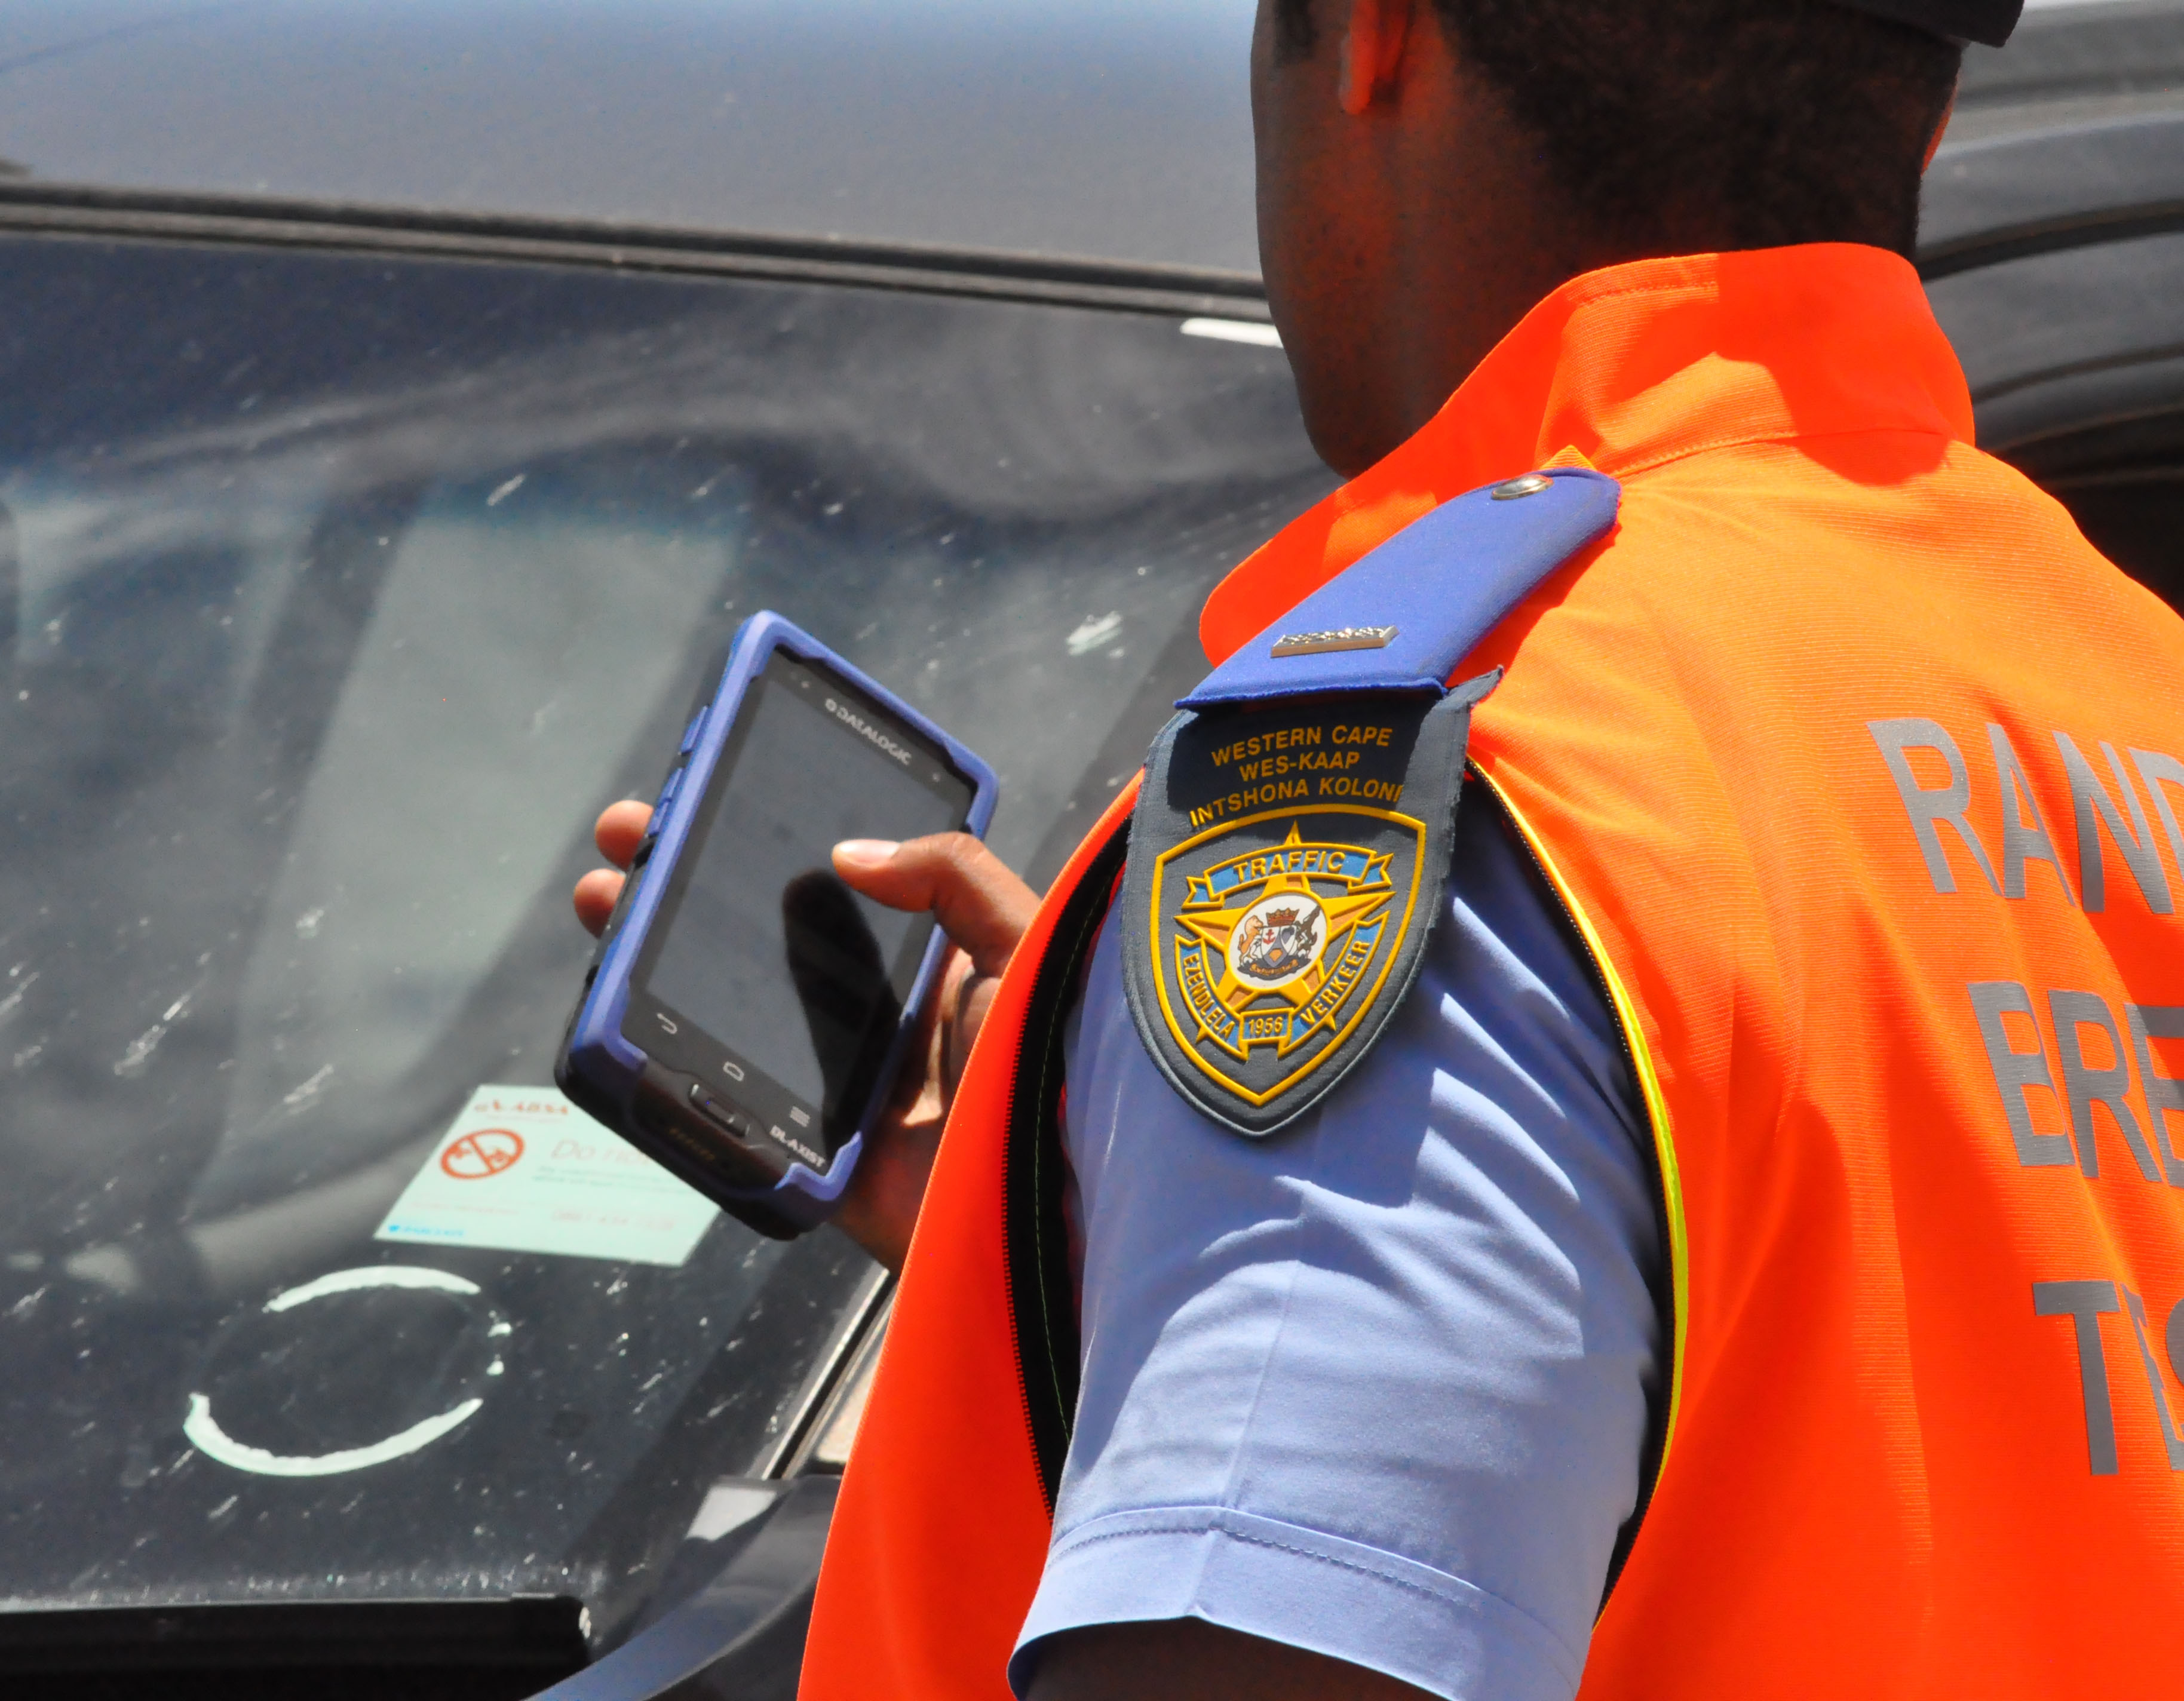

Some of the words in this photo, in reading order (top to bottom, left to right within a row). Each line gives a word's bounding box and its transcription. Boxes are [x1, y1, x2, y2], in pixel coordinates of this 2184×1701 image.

[837, 707, 912, 765] DATALOGIC
[1211, 726, 1322, 767] WESTERN
[1332, 724, 1393, 747] CAPE
[1240, 751, 1360, 781] WES-KAAP
[1189, 779, 1309, 827] INTSHONA
[1319, 778, 1404, 802] KOLONI
[1233, 850, 1345, 883] TRAFFIC
[1183, 953, 1235, 1034] EZENDLELA
[1300, 940, 1370, 1024] VERKEER
[1249, 1017, 1283, 1034] 1956
[2032, 1281, 2184, 1476] TE
